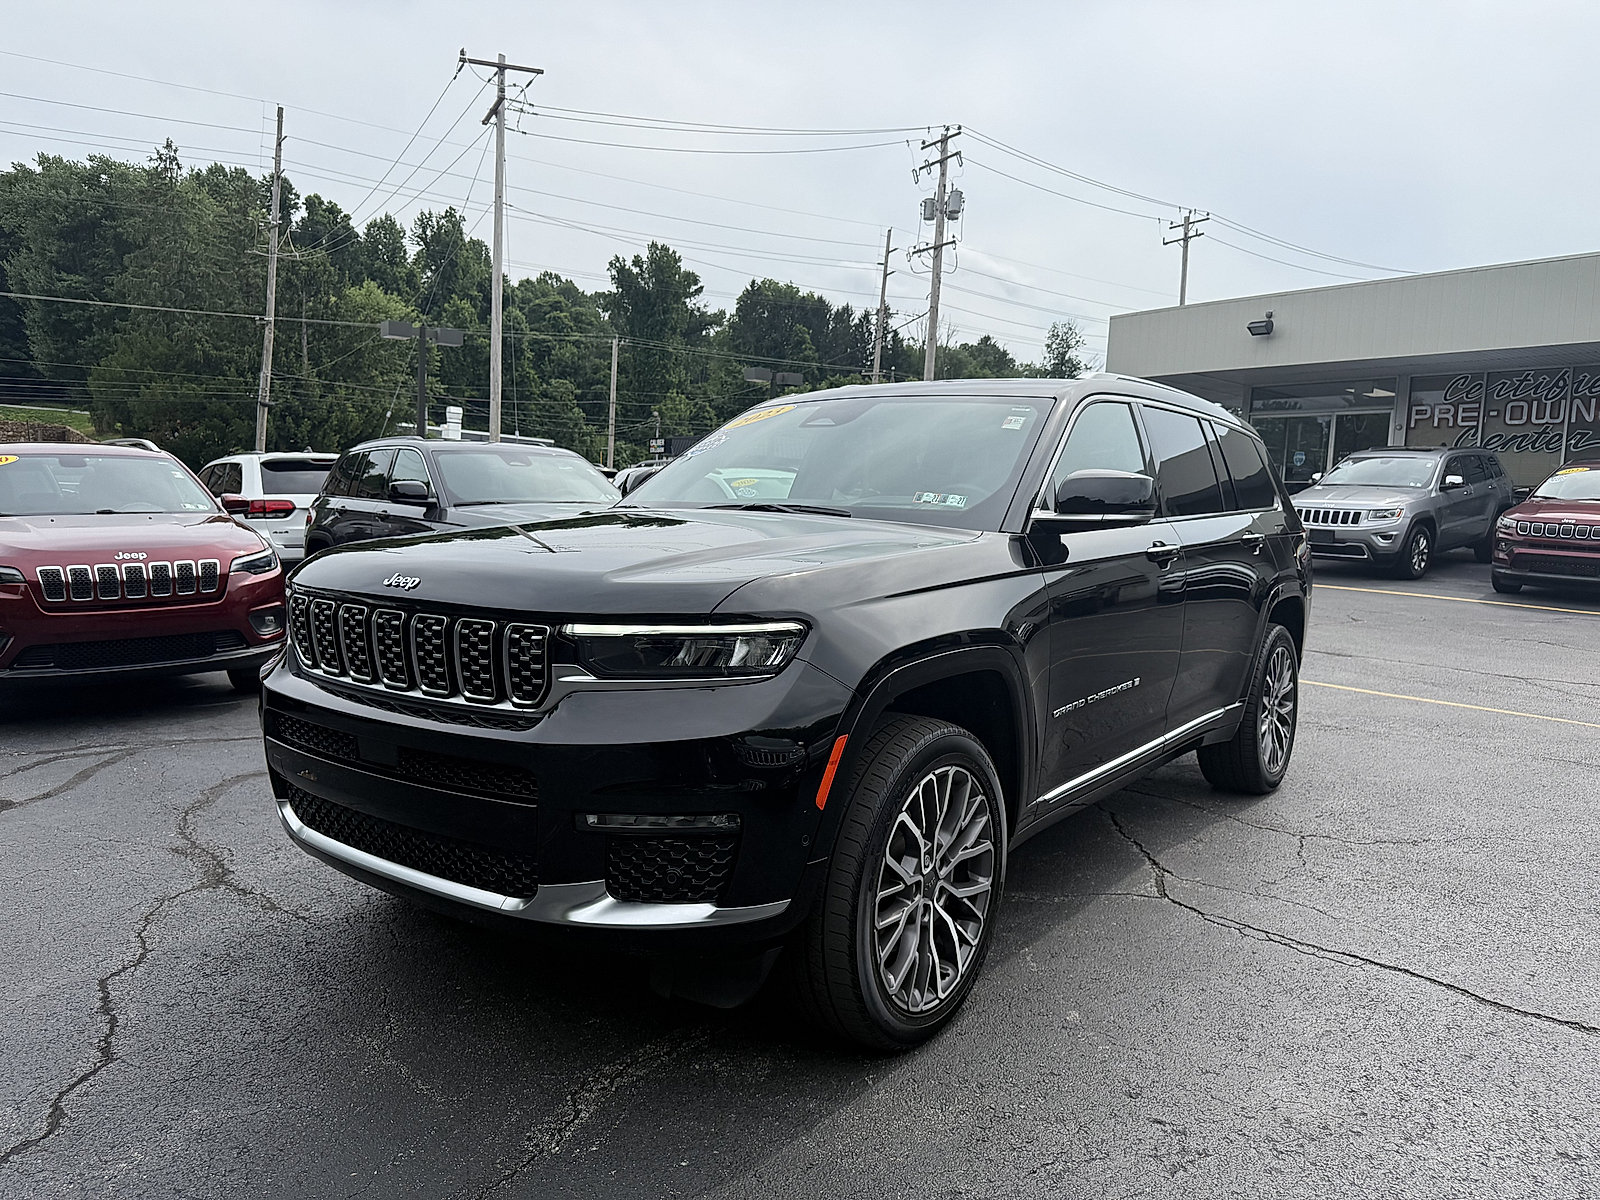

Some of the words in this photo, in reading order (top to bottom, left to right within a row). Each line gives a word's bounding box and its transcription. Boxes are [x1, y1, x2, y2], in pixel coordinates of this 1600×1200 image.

[1410, 398, 1600, 428] PRE-OWN
[114, 551, 147, 560] Jeep
[383, 572, 421, 591] Jeep
[1053, 699, 1086, 718] GRAND
[1087, 680, 1133, 704] CHEROKEE
